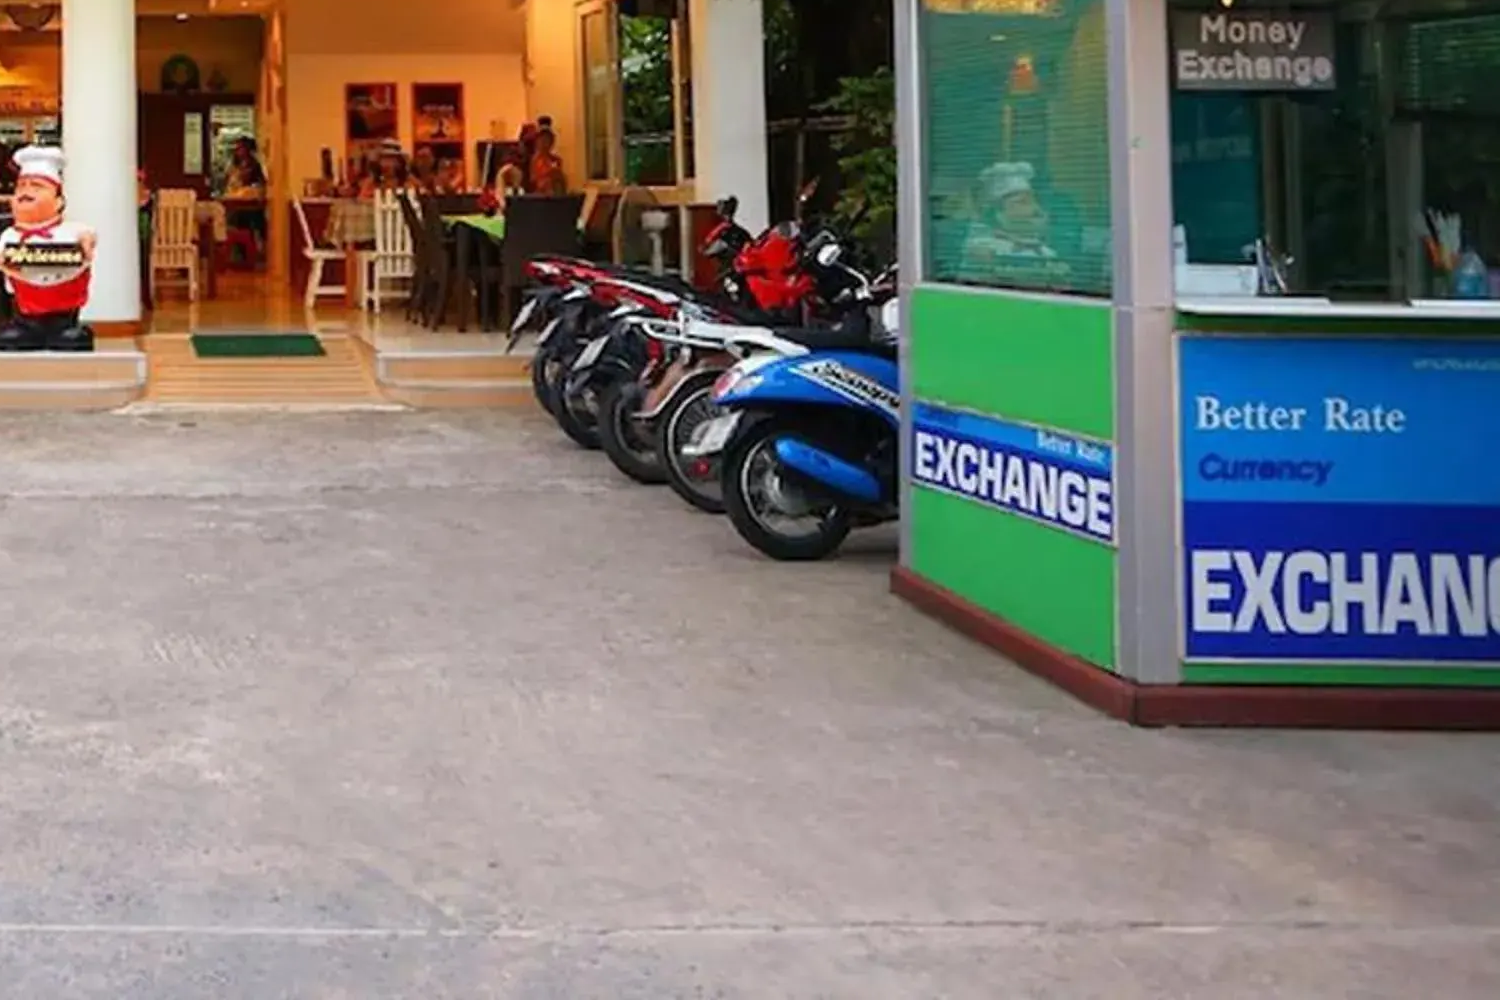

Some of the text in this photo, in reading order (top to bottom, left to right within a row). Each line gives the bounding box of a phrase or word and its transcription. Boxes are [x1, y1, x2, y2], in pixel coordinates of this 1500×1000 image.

[1201, 14, 1306, 50] Money
[1177, 50, 1333, 87] Exchange
[1195, 395, 1406, 433] Better Rate
[915, 431, 1112, 536] EXCHANGE
[1198, 452, 1334, 488] Currency
[1191, 550, 1500, 637] EXCHAN
